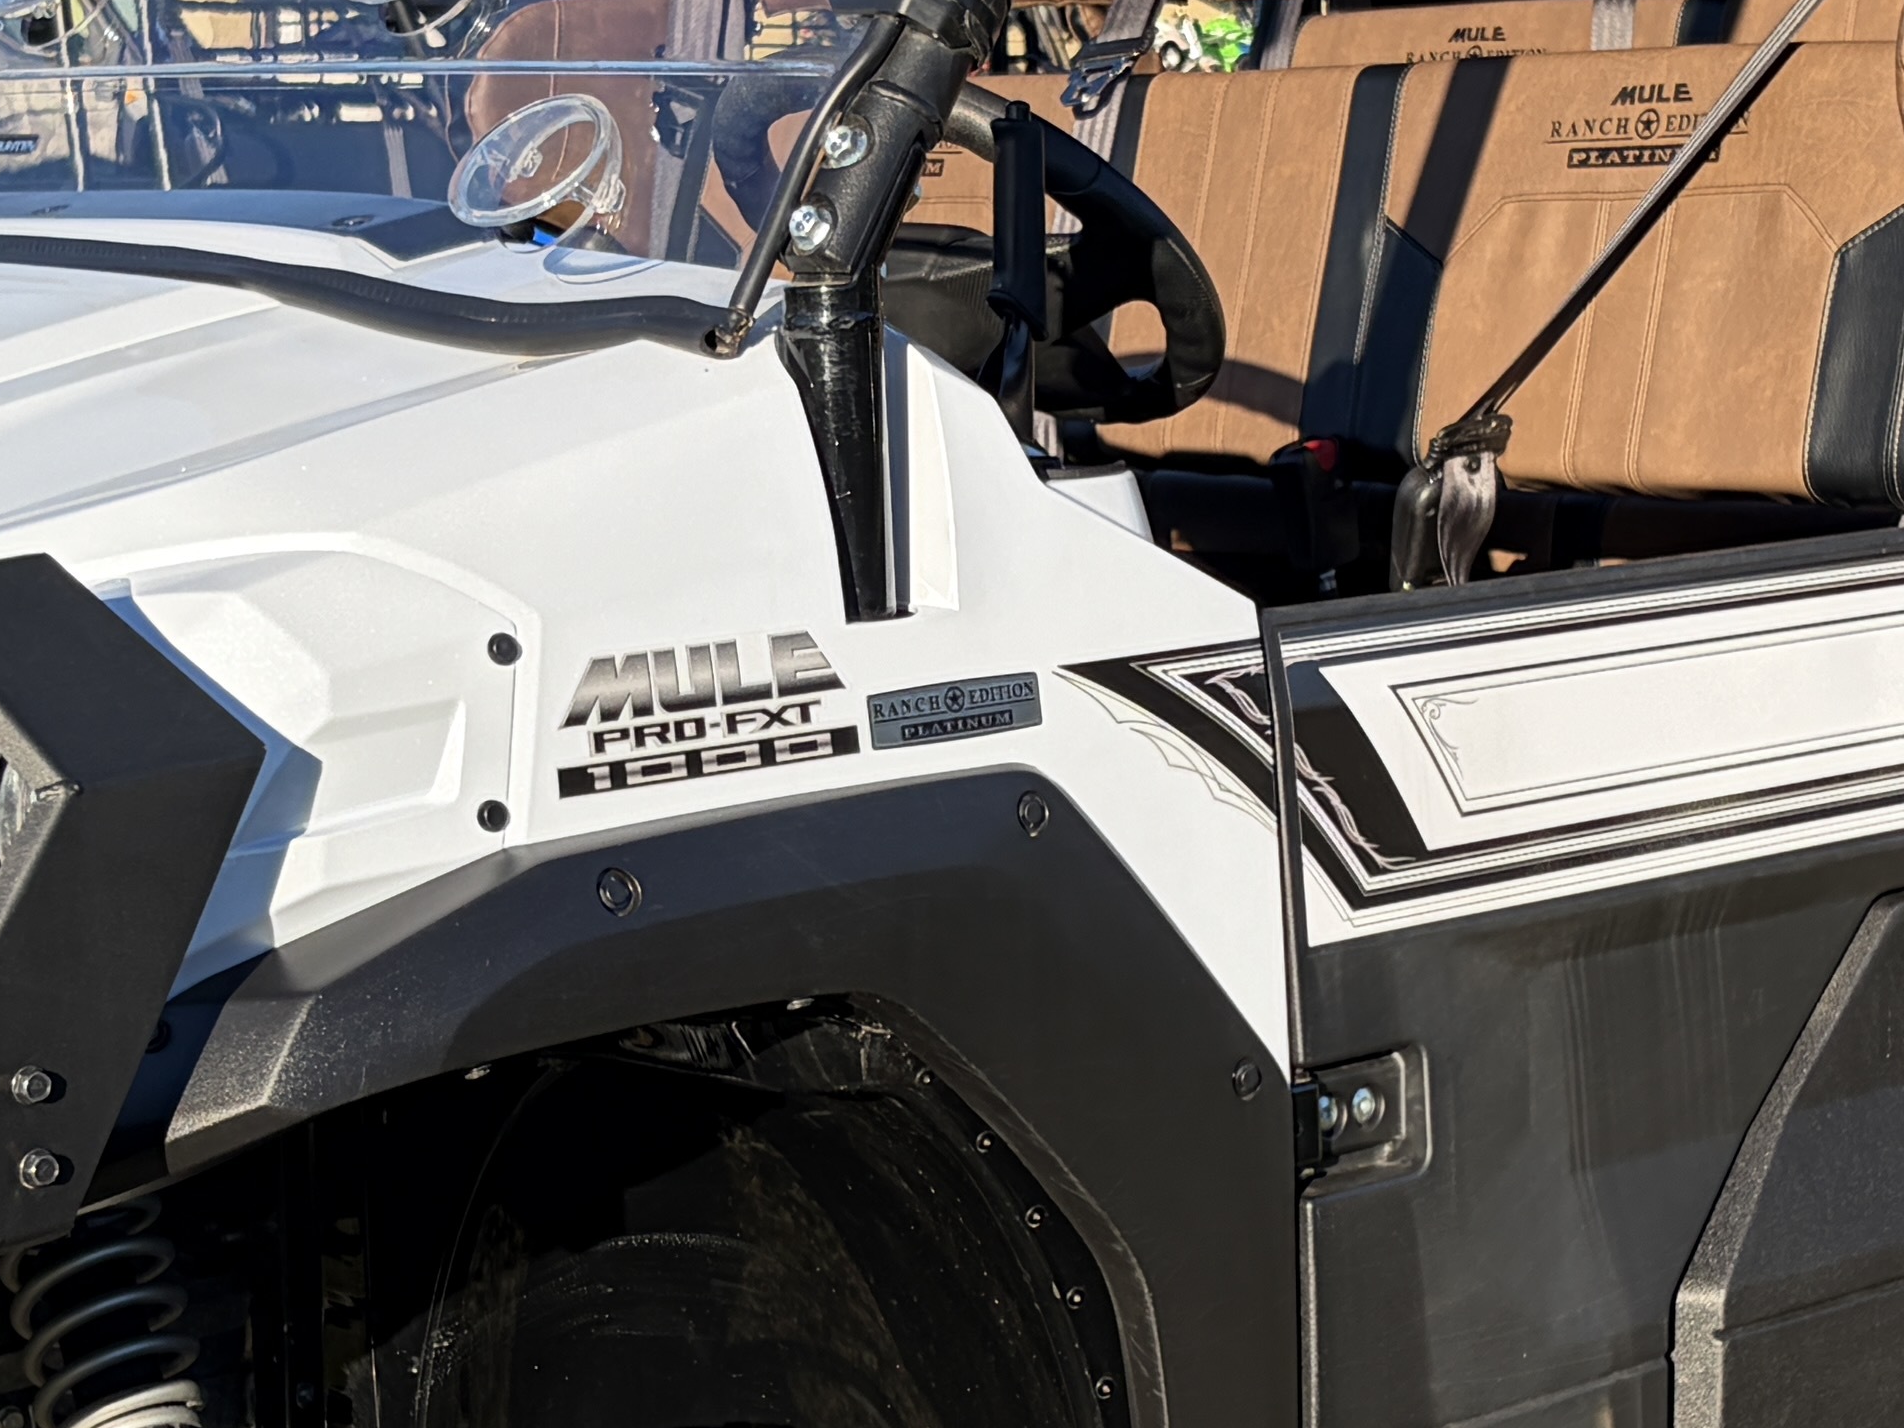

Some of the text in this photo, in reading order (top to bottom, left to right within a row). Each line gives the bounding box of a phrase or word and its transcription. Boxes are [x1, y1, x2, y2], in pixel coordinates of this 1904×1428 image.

[1448, 26, 1507, 43] MULE
[1610, 83, 1693, 106] MULE
[1550, 117, 1630, 138] RANCH
[558, 630, 846, 729] MULE
[873, 681, 1034, 719] RANCH EDITION
[590, 698, 823, 757] PRO-FXT
[903, 714, 1011, 738] PLATINUM
[587, 732, 833, 791] 1000
